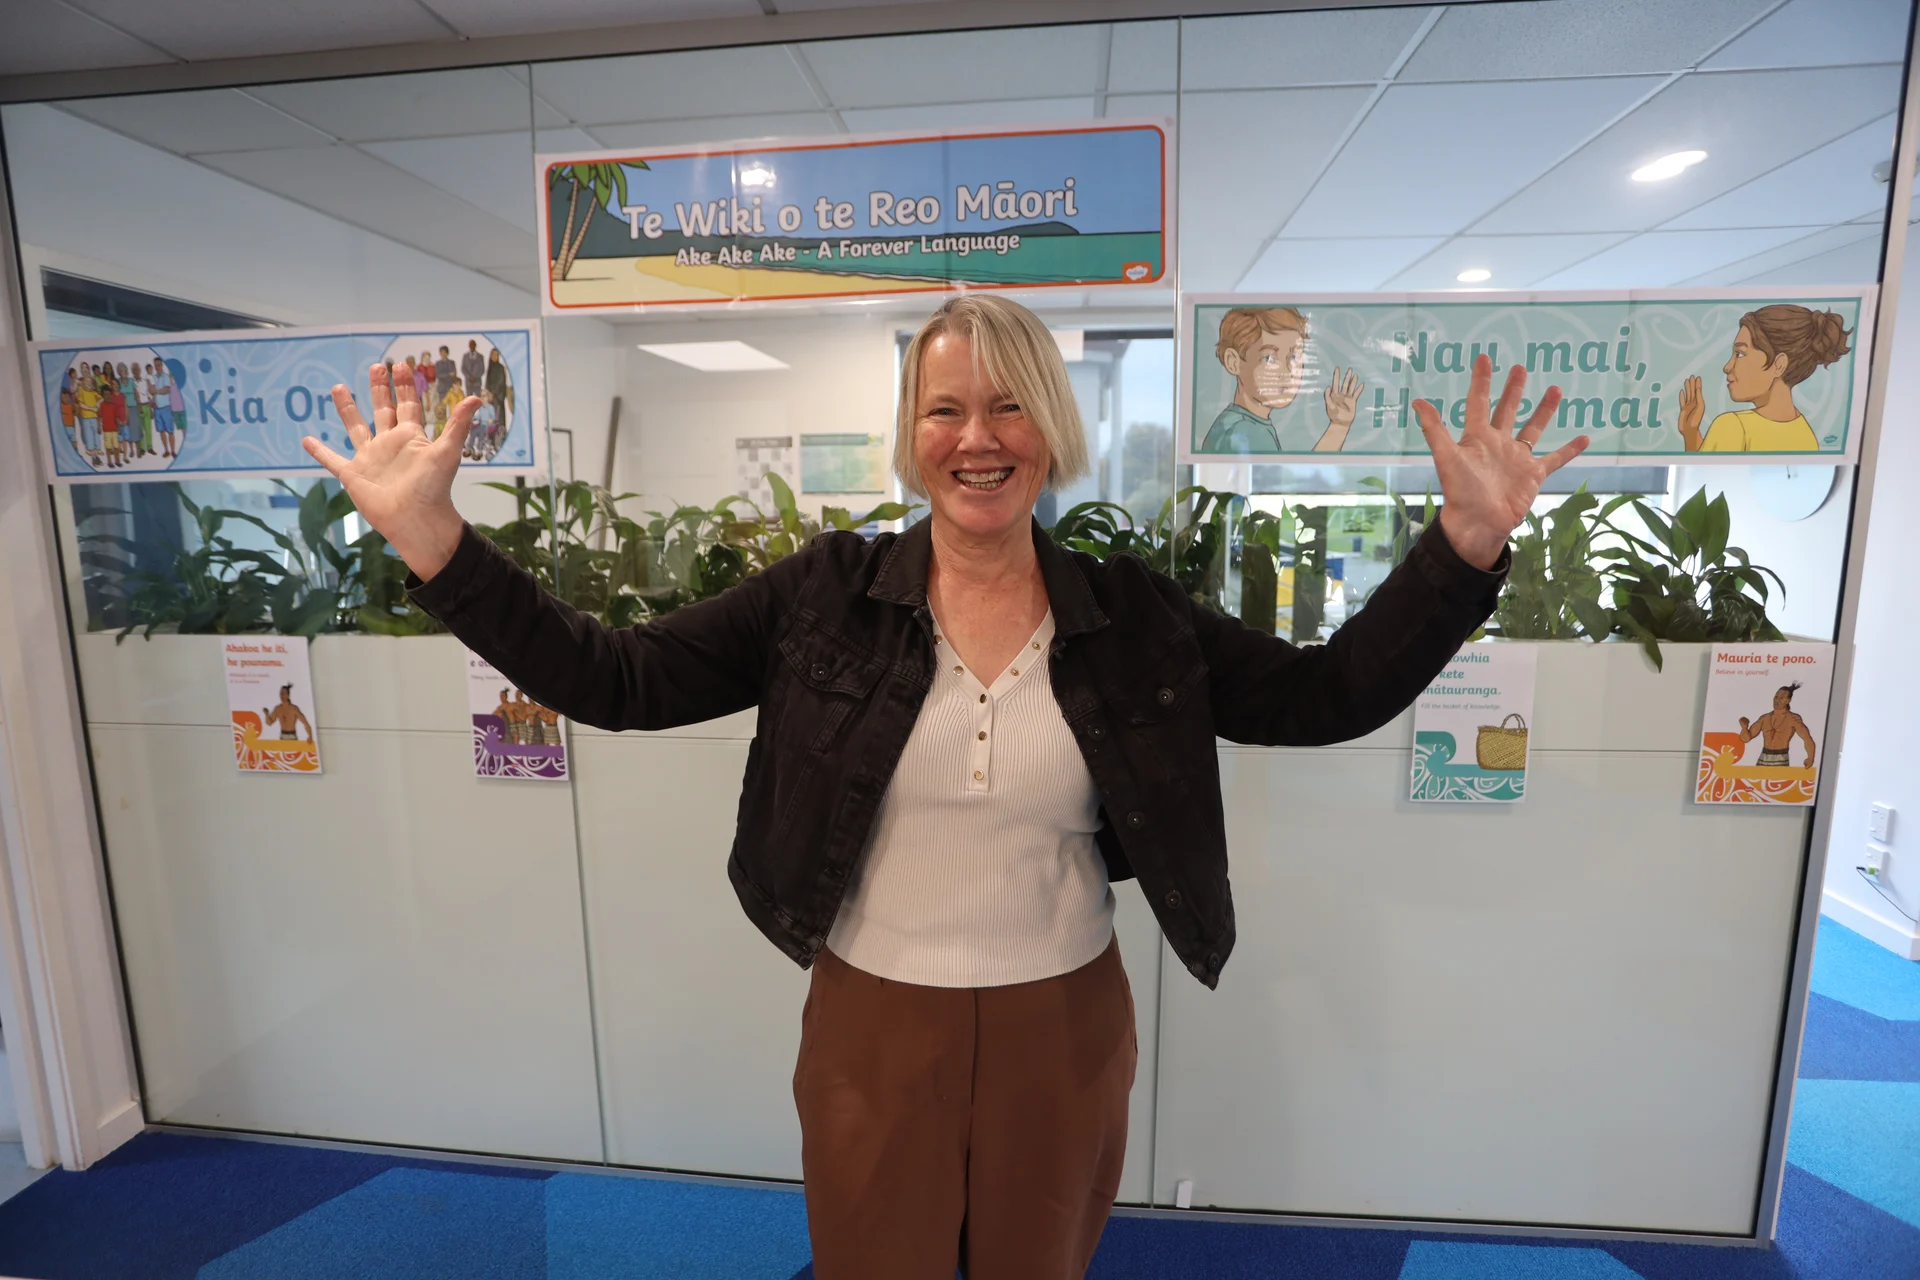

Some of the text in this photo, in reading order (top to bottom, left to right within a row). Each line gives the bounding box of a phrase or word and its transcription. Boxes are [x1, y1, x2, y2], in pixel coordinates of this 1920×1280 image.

[622, 177, 1079, 240] Te Wiki o te Reo Māori
[675, 246, 711, 266] Ake
[718, 244, 753, 264] Ake
[759, 242, 796, 262] Ake
[817, 240, 833, 260] A
[839, 239, 914, 259] Forever
[920, 234, 1020, 257] Language
[1391, 325, 1647, 381] Nau mai,
[197, 385, 356, 425] Kia Or
[1556, 382, 1662, 429] mai
[1717, 652, 1816, 667] Mauria te pono.
